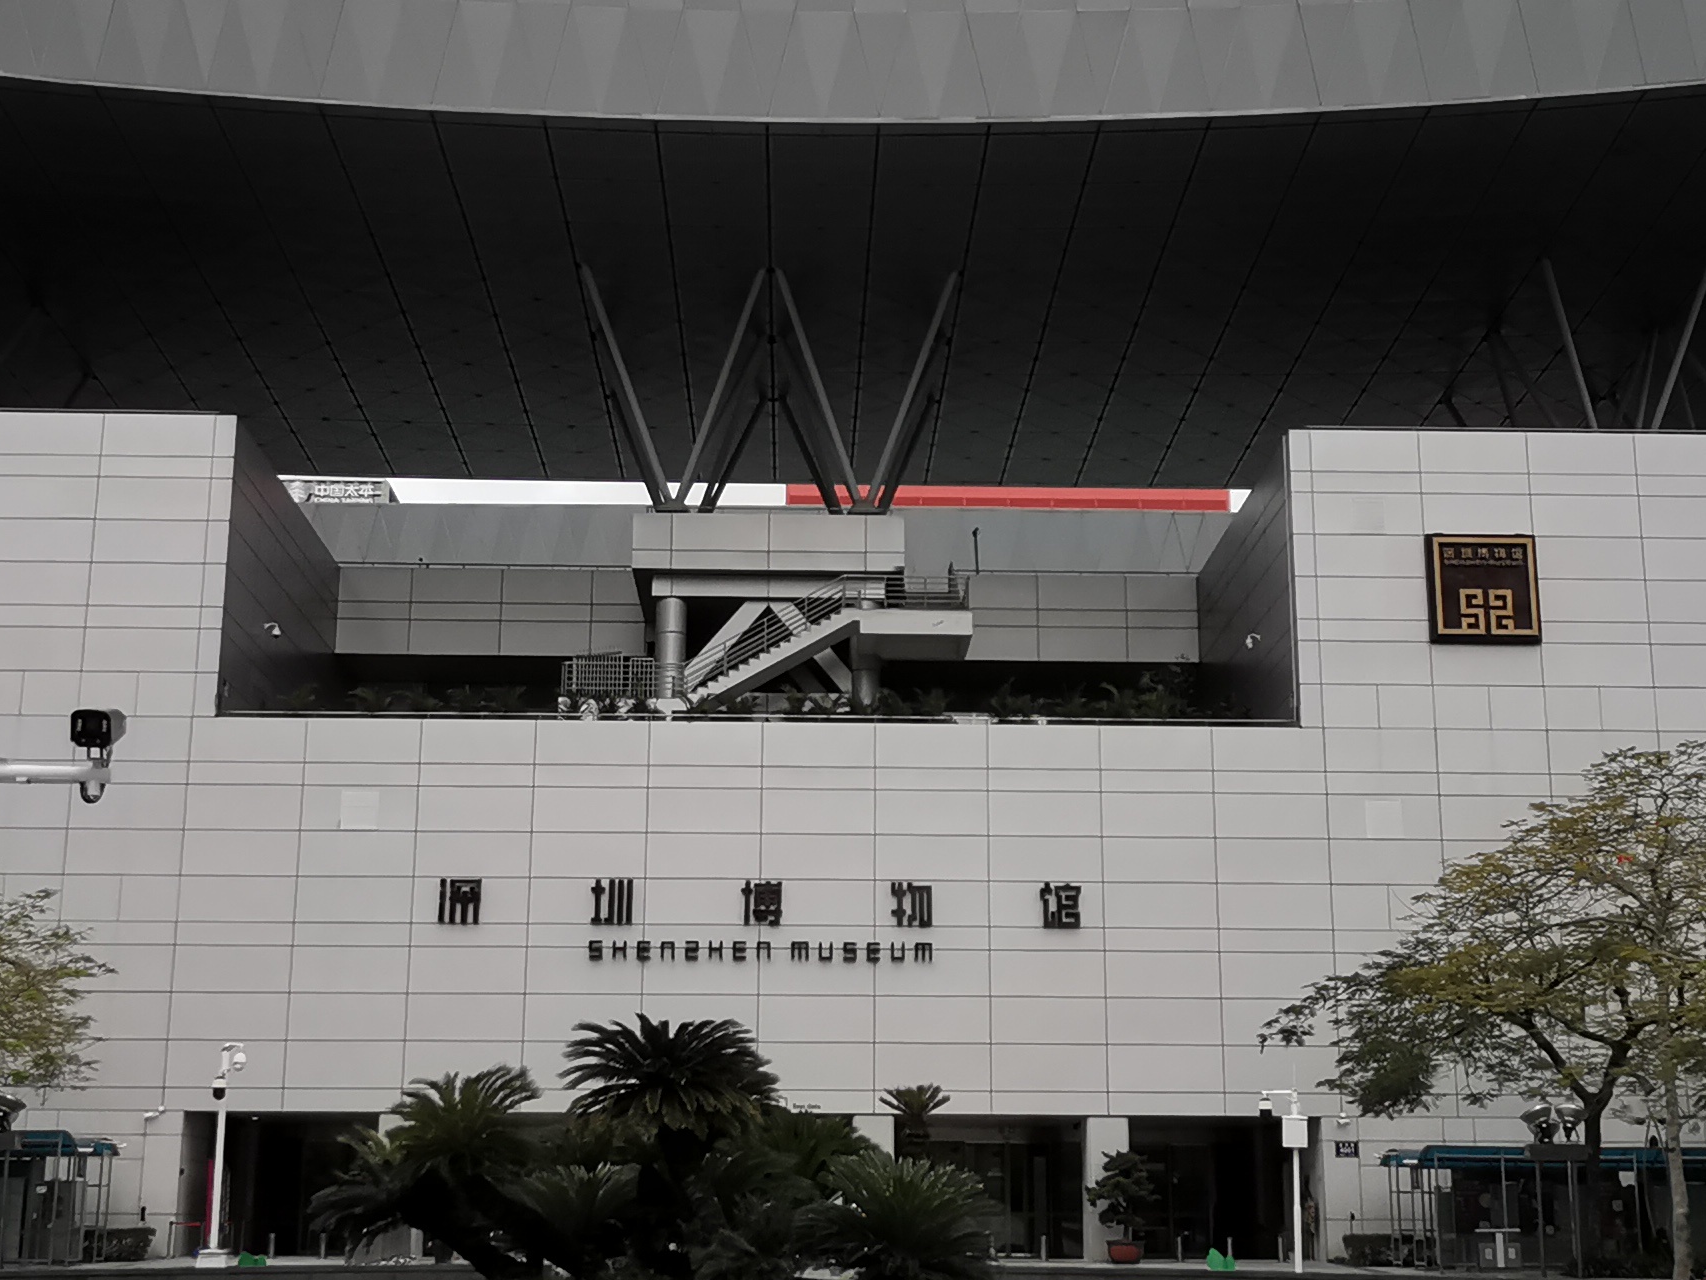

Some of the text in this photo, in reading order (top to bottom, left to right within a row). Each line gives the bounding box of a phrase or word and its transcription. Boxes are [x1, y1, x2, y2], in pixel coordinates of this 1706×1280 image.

[314, 483, 374, 497] 中国太平
[437, 877, 1082, 929] 深圳博物馆
[587, 939, 933, 967] SHENZHEN MUSEUM
